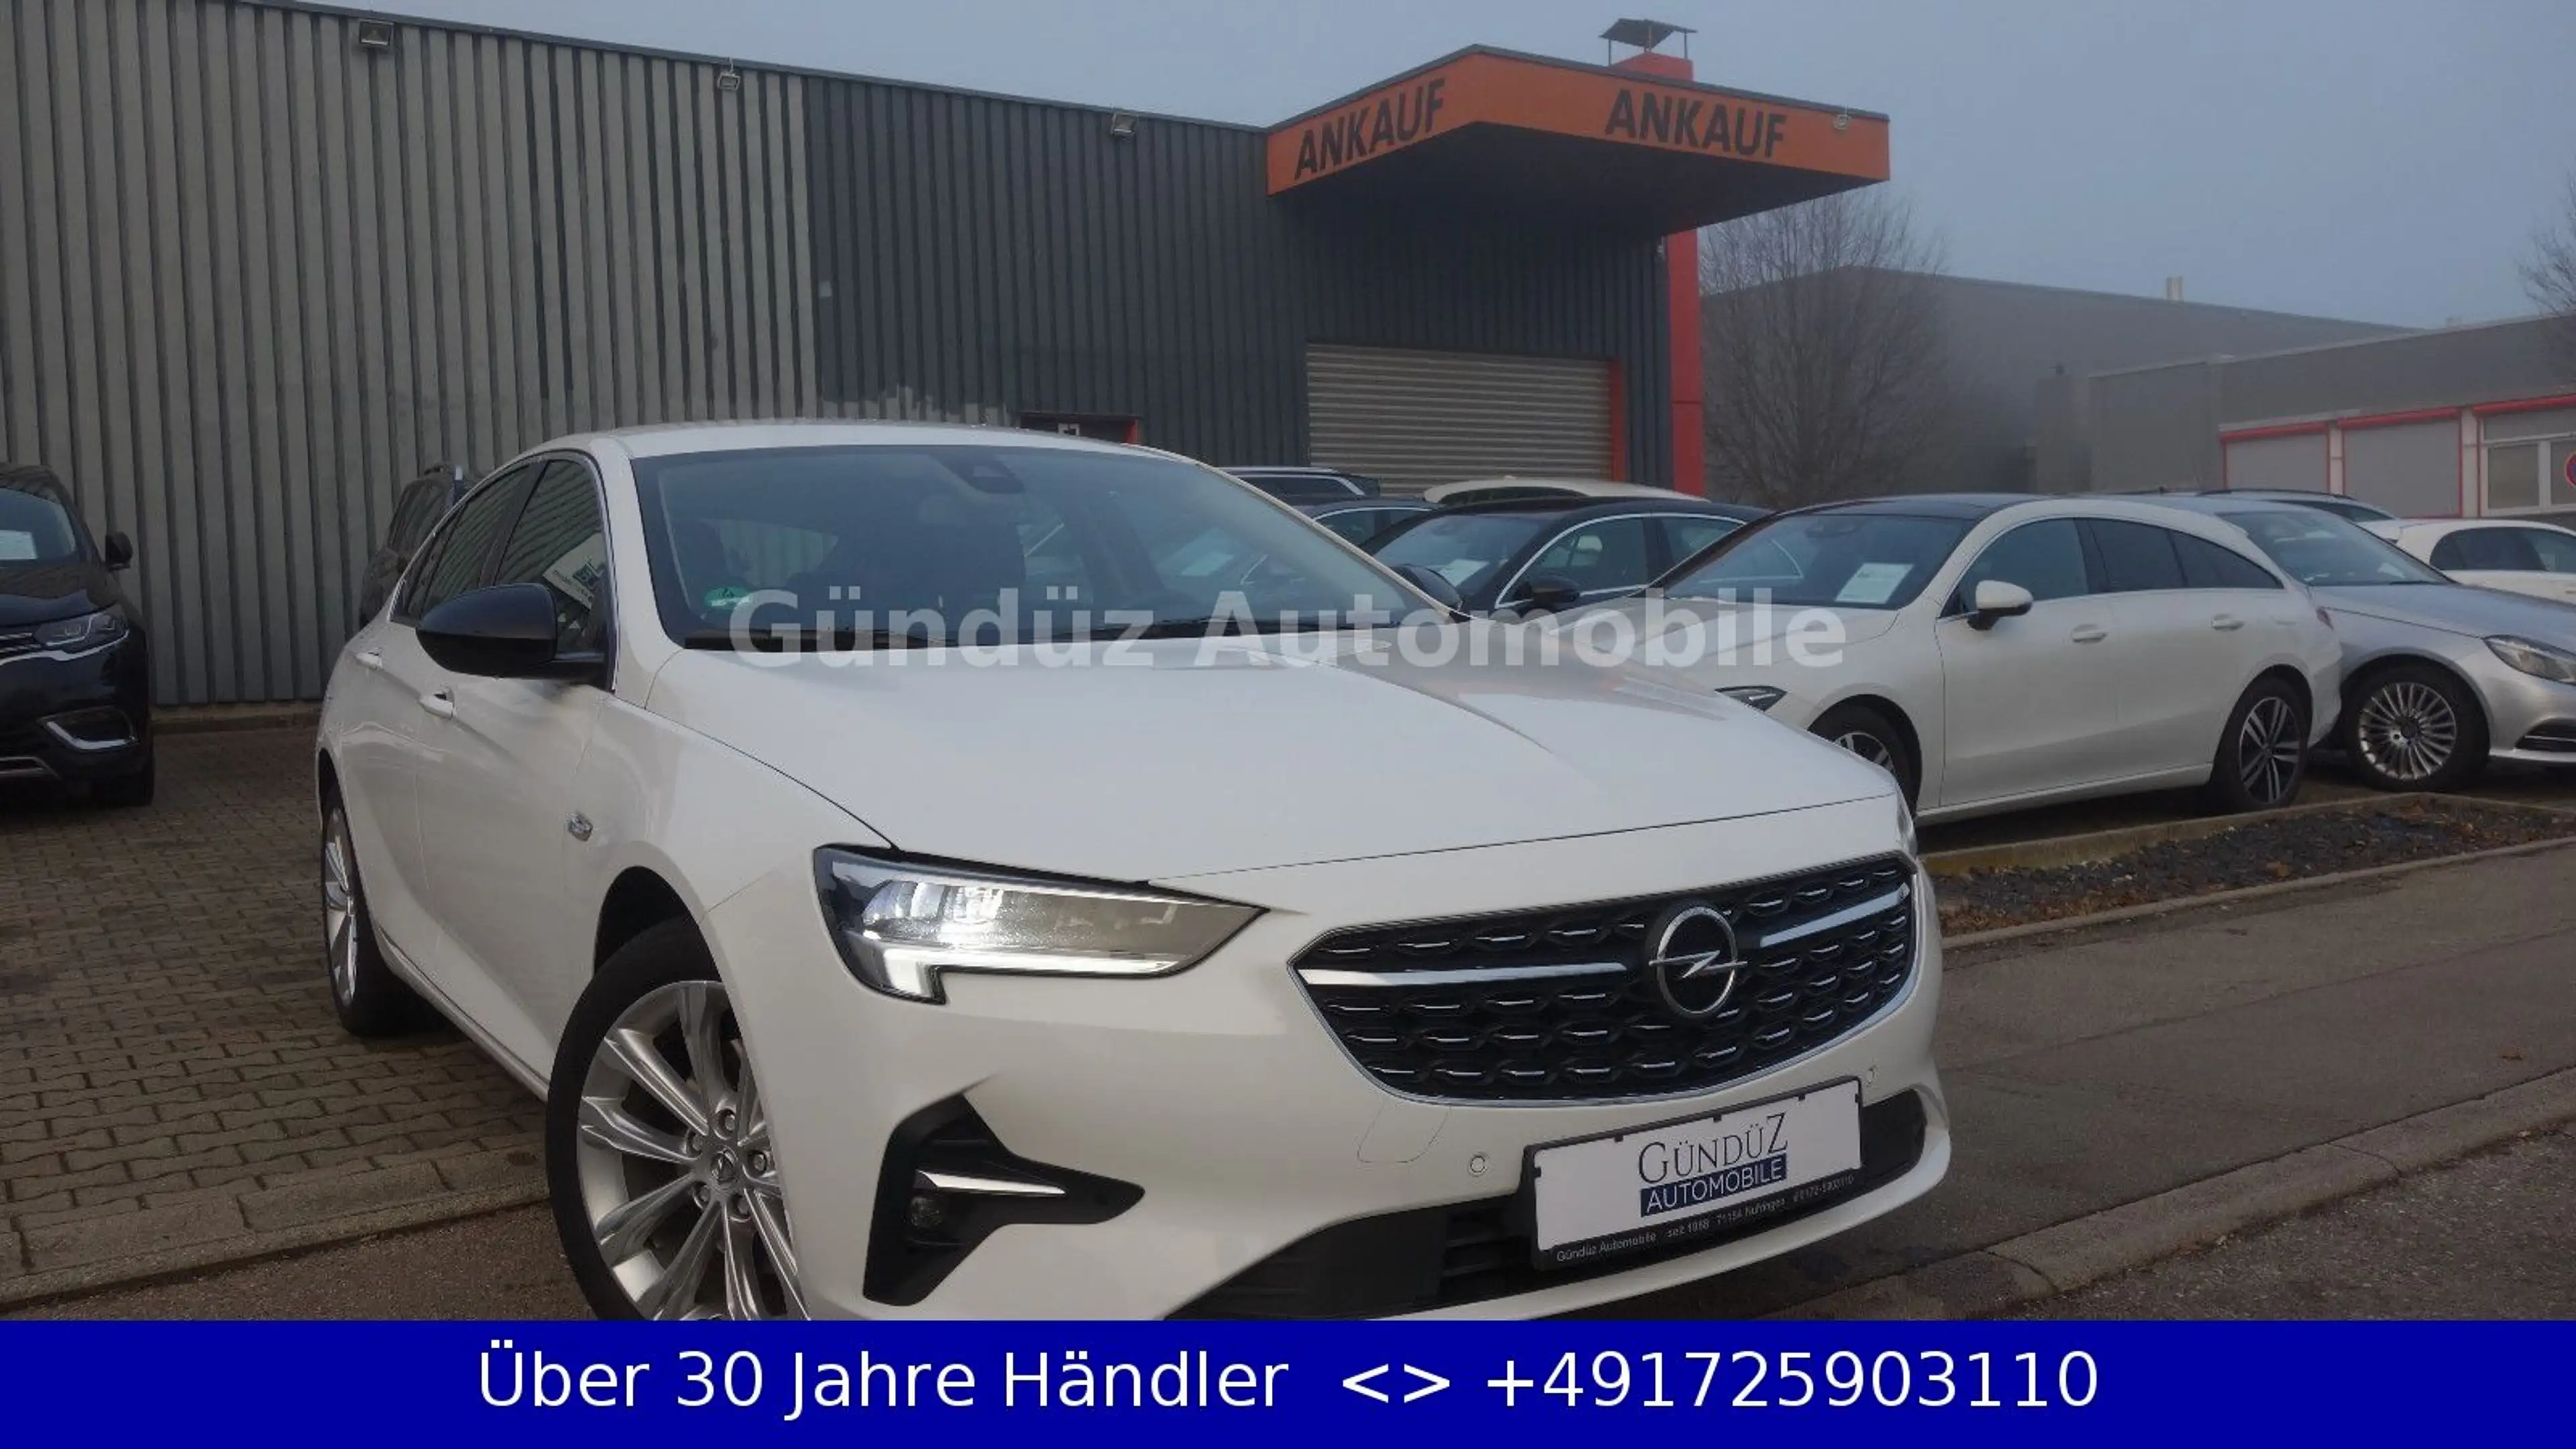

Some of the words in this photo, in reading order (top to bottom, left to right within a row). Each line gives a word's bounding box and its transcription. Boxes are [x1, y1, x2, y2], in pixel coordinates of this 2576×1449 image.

[1294, 77, 1445, 180] ANKAUF
[1605, 89, 1786, 157] ANKAUF
[1646, 1158, 1782, 1213] AUTOMOBILE
[1599, 1233, 1656, 1254] Automobile
